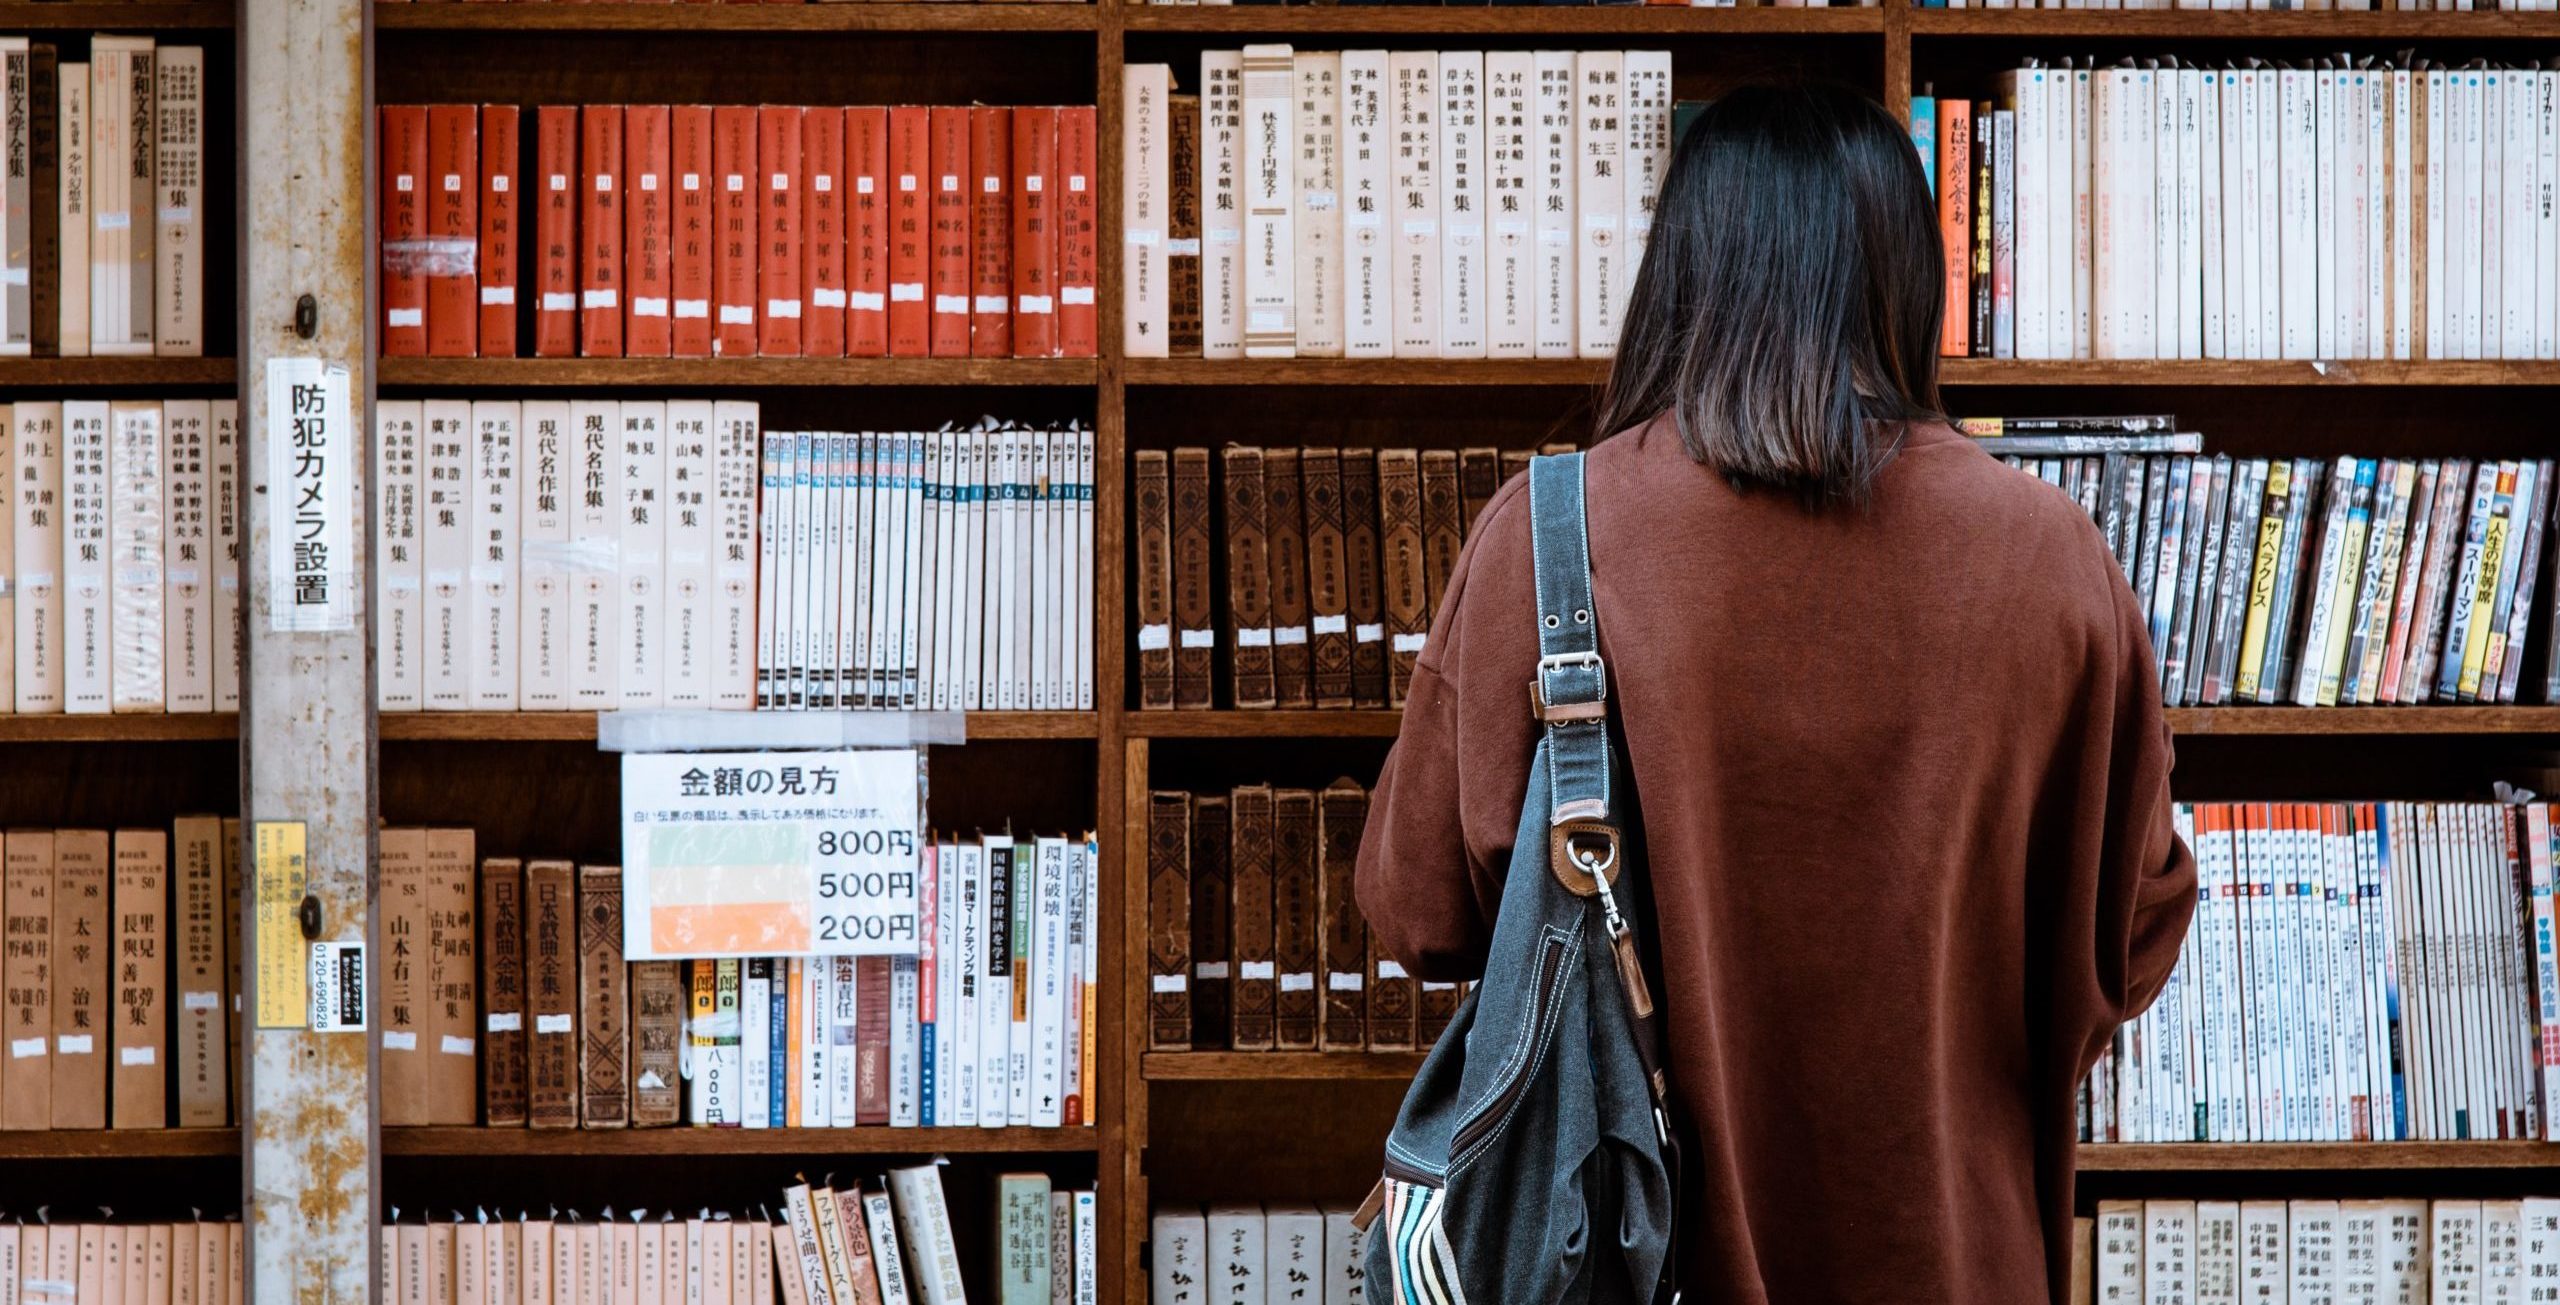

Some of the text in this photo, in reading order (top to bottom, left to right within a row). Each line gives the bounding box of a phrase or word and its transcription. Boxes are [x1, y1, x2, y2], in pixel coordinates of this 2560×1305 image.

[1596, 160, 1611, 177] 集
[1408, 192, 1423, 208] 集
[1502, 195, 1517, 212] 集
[539, 420, 557, 512] 現代名作集
[586, 415, 604, 507] 現代名作集
[292, 384, 328, 605] 防犯カメラ設置
[32, 509, 47, 527] 集
[439, 510, 454, 526] 集
[632, 507, 647, 524] 集
[682, 511, 696, 526] 集
[82, 544, 97, 561] 集
[181, 544, 196, 561] 集
[392, 546, 406, 562] 集
[729, 544, 744, 560] 集
[681, 766, 838, 796] 金額の見方
[819, 830, 912, 856] 800円
[820, 872, 913, 898] 500円
[1044, 846, 1061, 916] 環境破壊
[85, 885, 97, 897] 88
[820, 914, 914, 940] 200円
[22, 1008, 33, 1025] 集
[131, 1008, 146, 1025] 集
